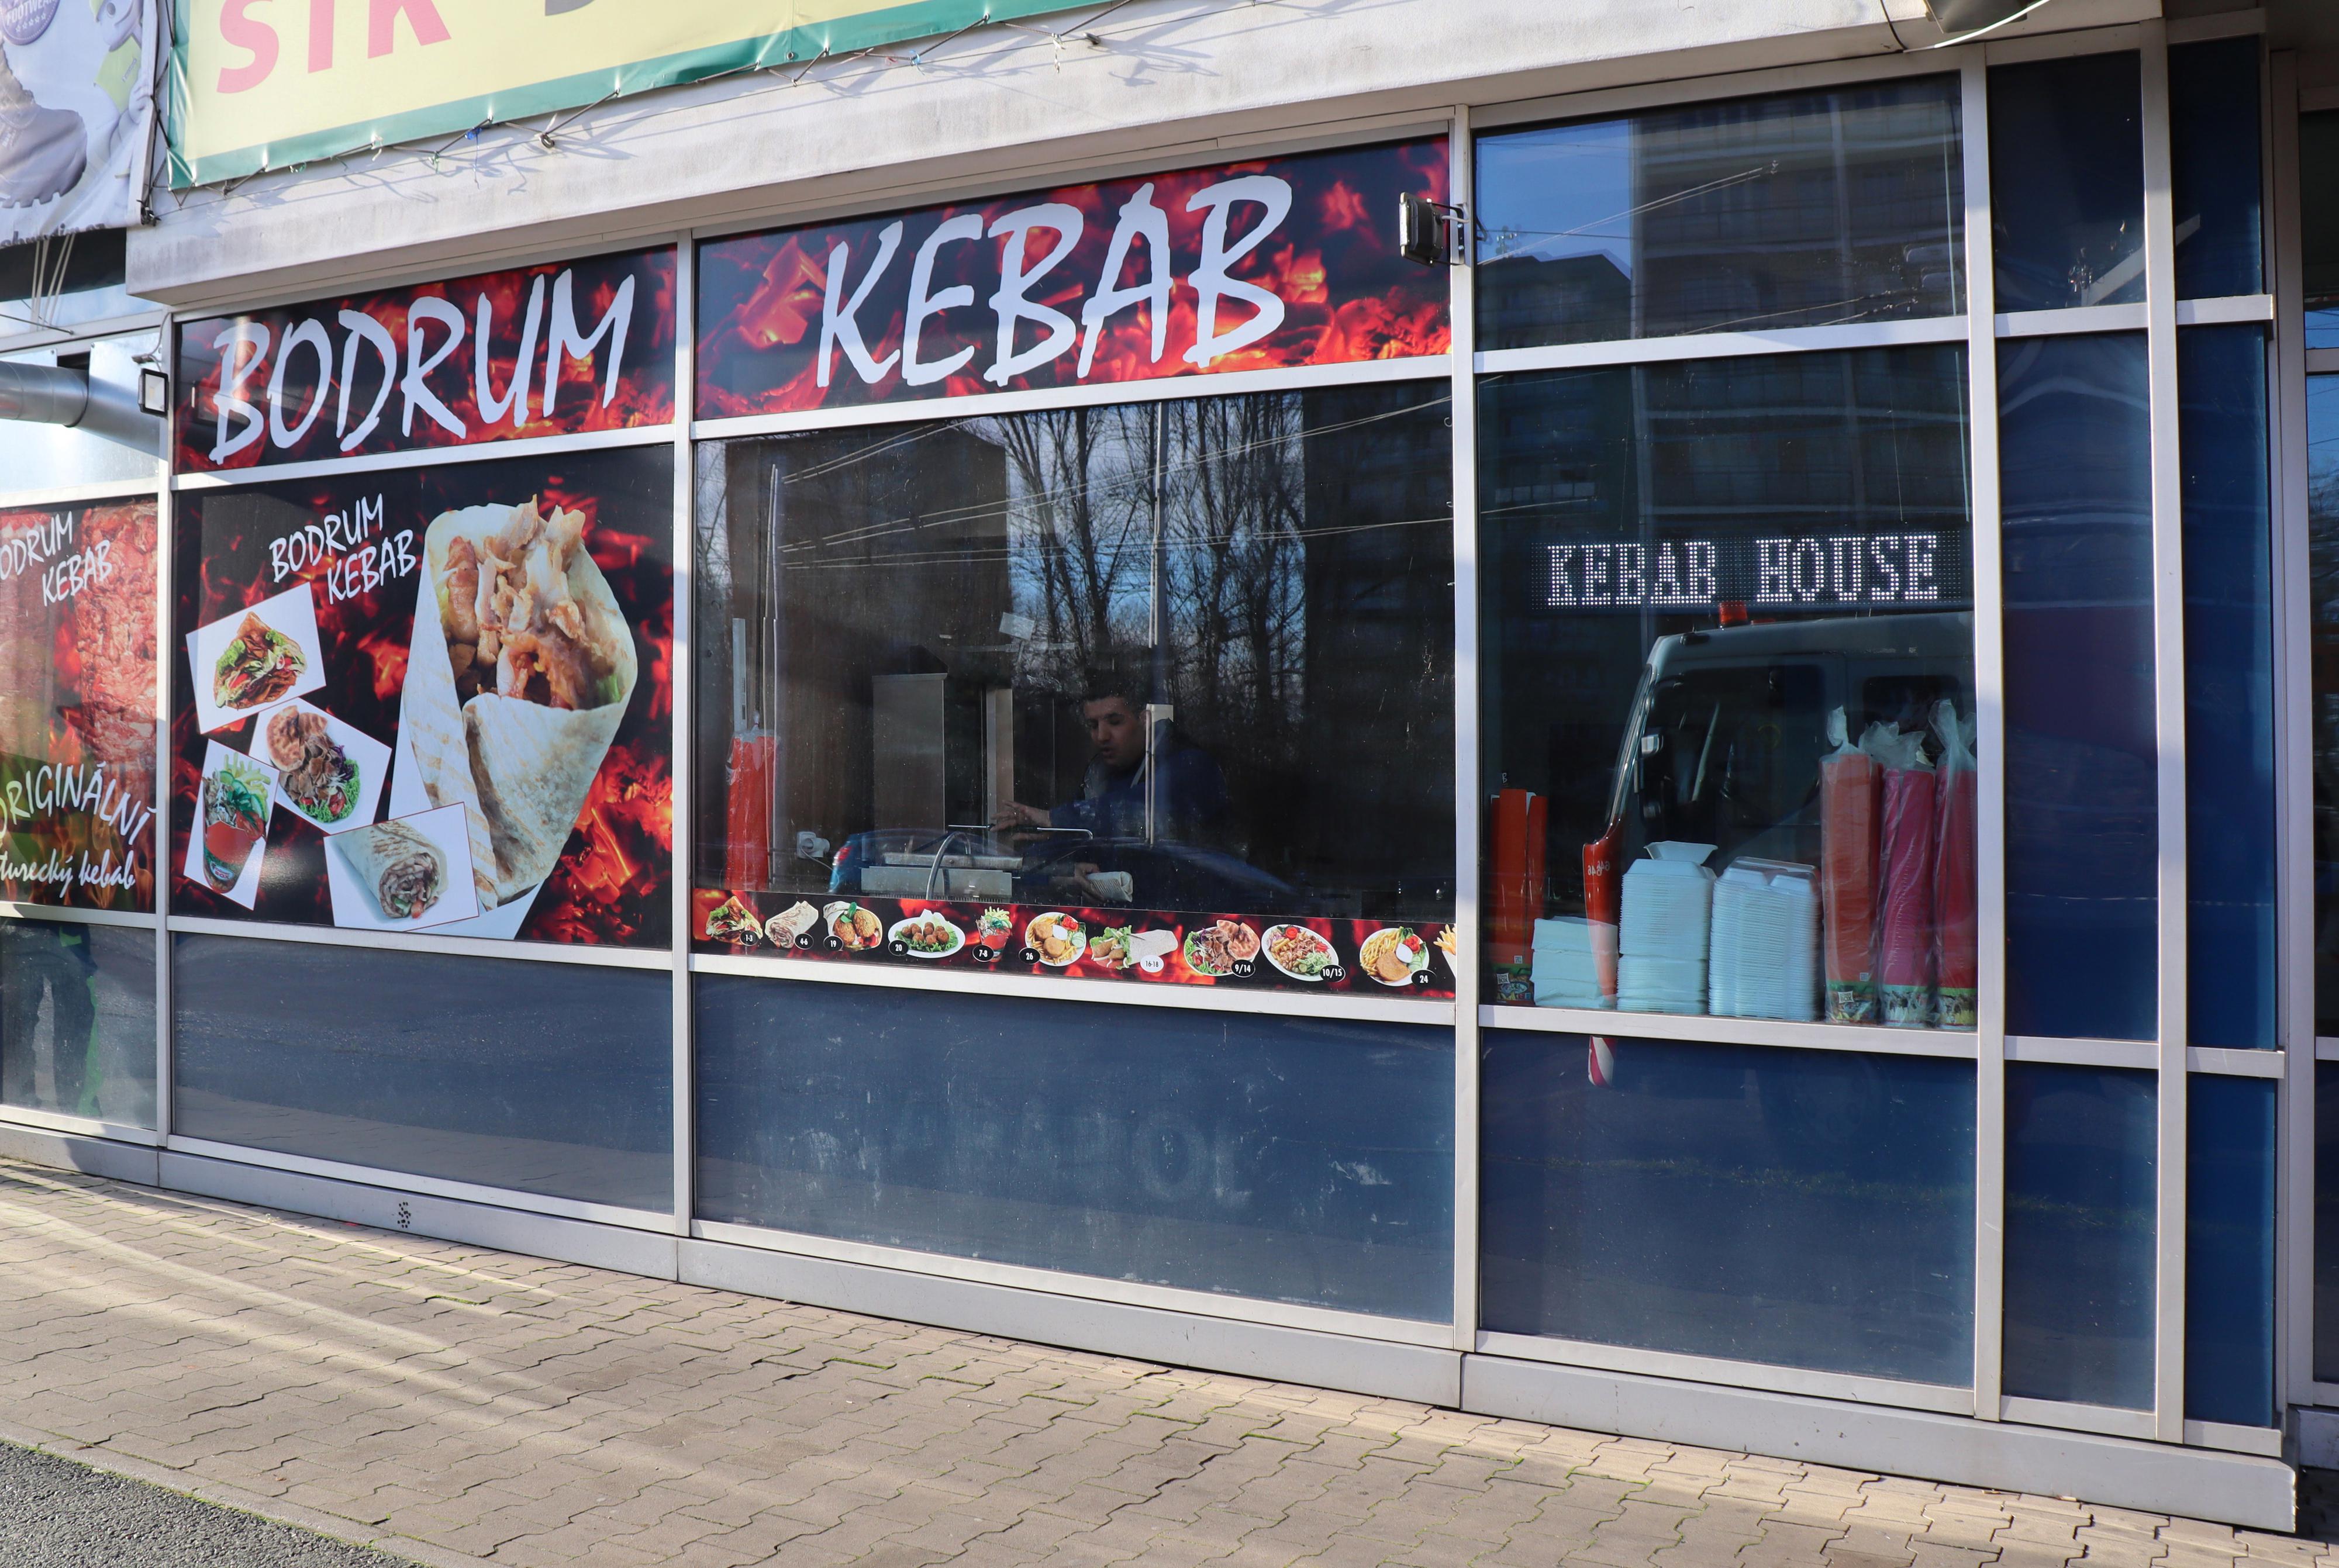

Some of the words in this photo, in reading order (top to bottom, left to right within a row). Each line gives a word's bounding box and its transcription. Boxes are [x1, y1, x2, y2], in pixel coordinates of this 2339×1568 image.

[5, 0, 54, 26] FOOTWE
[209, 268, 635, 465] BODRUM
[816, 174, 1293, 388] KEBAB
[268, 493, 384, 583] BODRUM
[42, 539, 113, 607] KEBAB
[327, 529, 416, 605] KEBAB
[1547, 541, 1716, 606] KEBAB
[1756, 535, 1938, 602] HOUSE
[78, 849, 136, 890] kebab
[830, 940, 837, 948] 19
[895, 944, 902, 952] 20
[1234, 963, 1251, 974] 9/14
[1322, 968, 1343, 978] 10/15
[1419, 975, 1428, 983] 24
